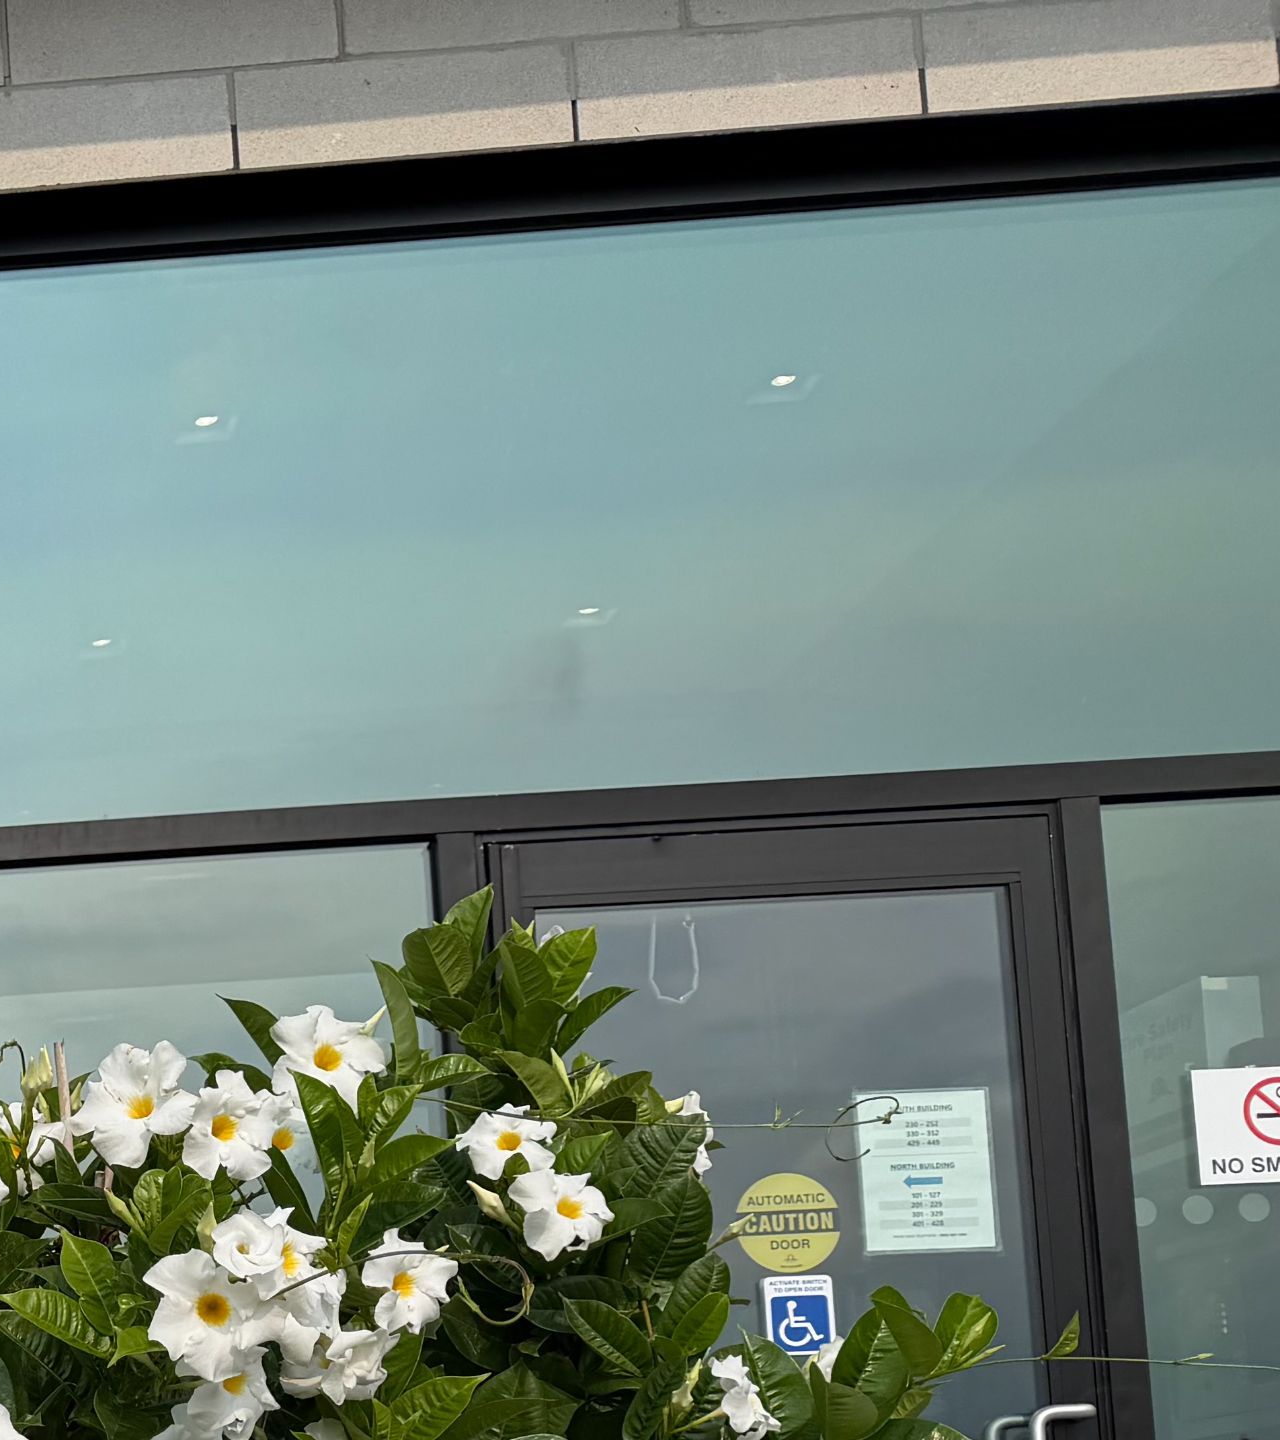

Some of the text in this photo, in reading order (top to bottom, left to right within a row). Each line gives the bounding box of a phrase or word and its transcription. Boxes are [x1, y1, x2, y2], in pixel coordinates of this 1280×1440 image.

[917, 1104, 953, 1112] BUILDING
[890, 1162, 956, 1172] NORTH BUILDING
[1211, 1158, 1244, 1174] NO
[747, 1193, 826, 1206] AUTOMATIC
[745, 1211, 834, 1233] CAUTION
[770, 1239, 811, 1250] DOOR
